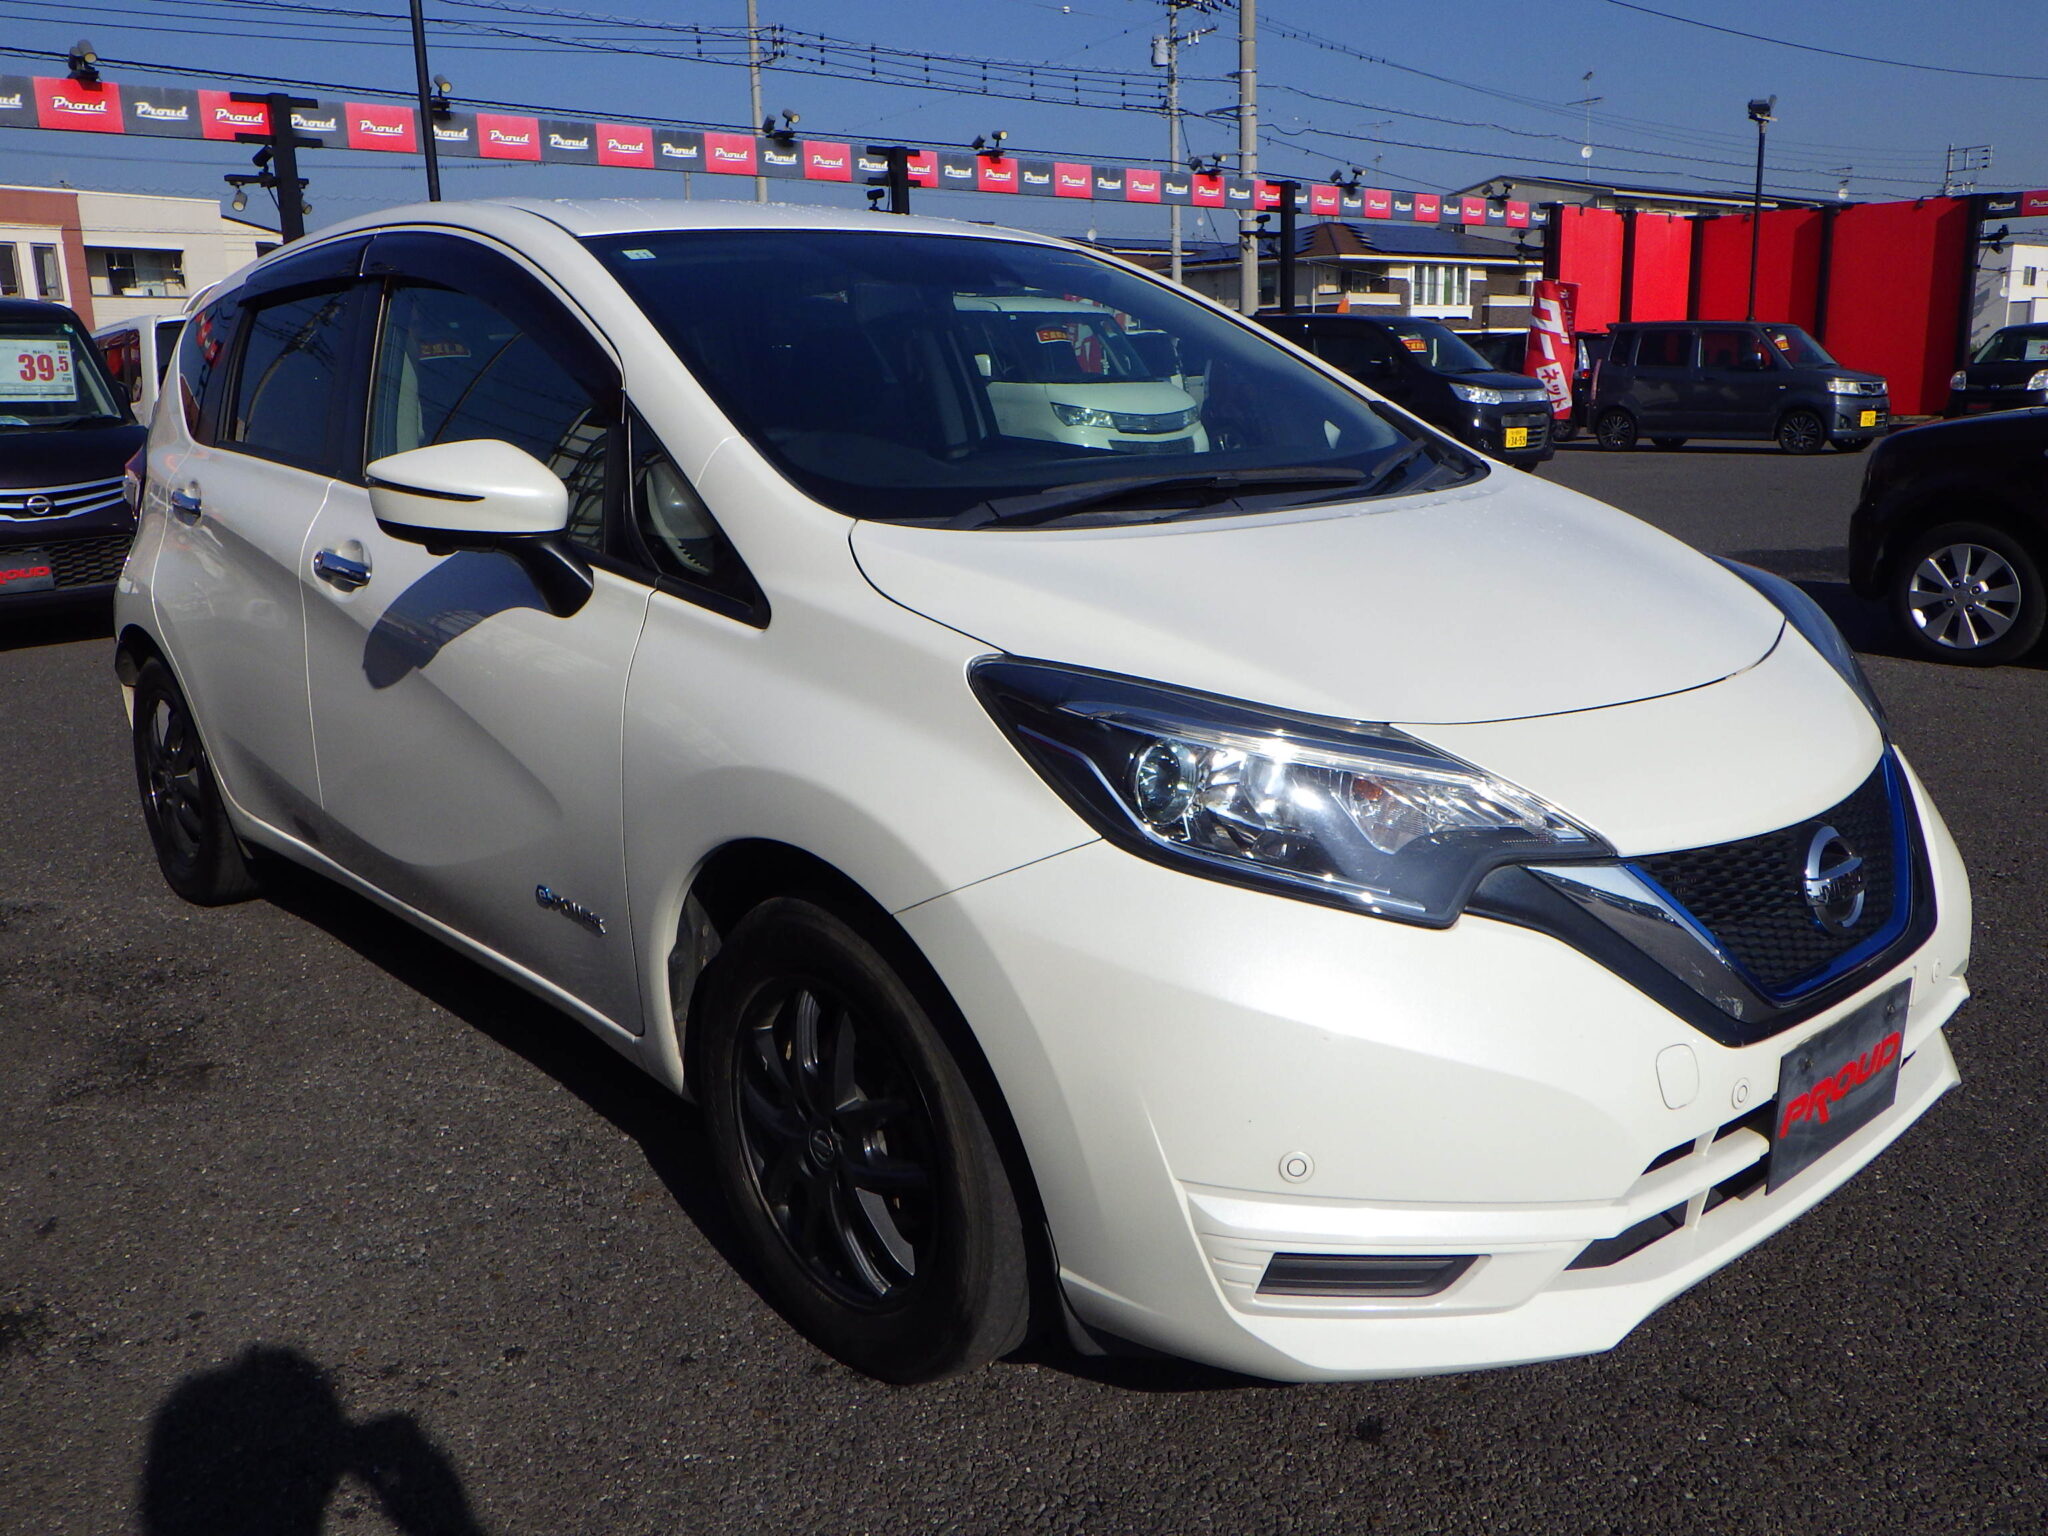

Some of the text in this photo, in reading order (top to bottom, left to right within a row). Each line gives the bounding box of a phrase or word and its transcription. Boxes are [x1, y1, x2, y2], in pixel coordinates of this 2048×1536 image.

[52, 96, 107, 114] Proud
[134, 101, 189, 121] Proud
[215, 108, 264, 126] Proud
[290, 113, 337, 132] Proud
[359, 119, 404, 136] Proud
[433, 124, 469, 141] roud
[489, 129, 530, 146] Proud
[548, 133, 589, 150] Proud
[607, 138, 644, 154] Proud
[661, 142, 698, 158] Proud
[714, 147, 748, 162] Proud
[763, 150, 798, 165] Proud
[812, 154, 844, 169] Proud
[857, 157, 889, 172] Proud
[906, 162, 931, 175] roud
[944, 164, 973, 179] Proud
[985, 168, 1012, 181] Proud
[1023, 171, 1050, 184] Proud
[1061, 174, 1086, 187] Proud
[1097, 177, 1122, 190] Proud
[1778, 1031, 1901, 1139] PROUD
